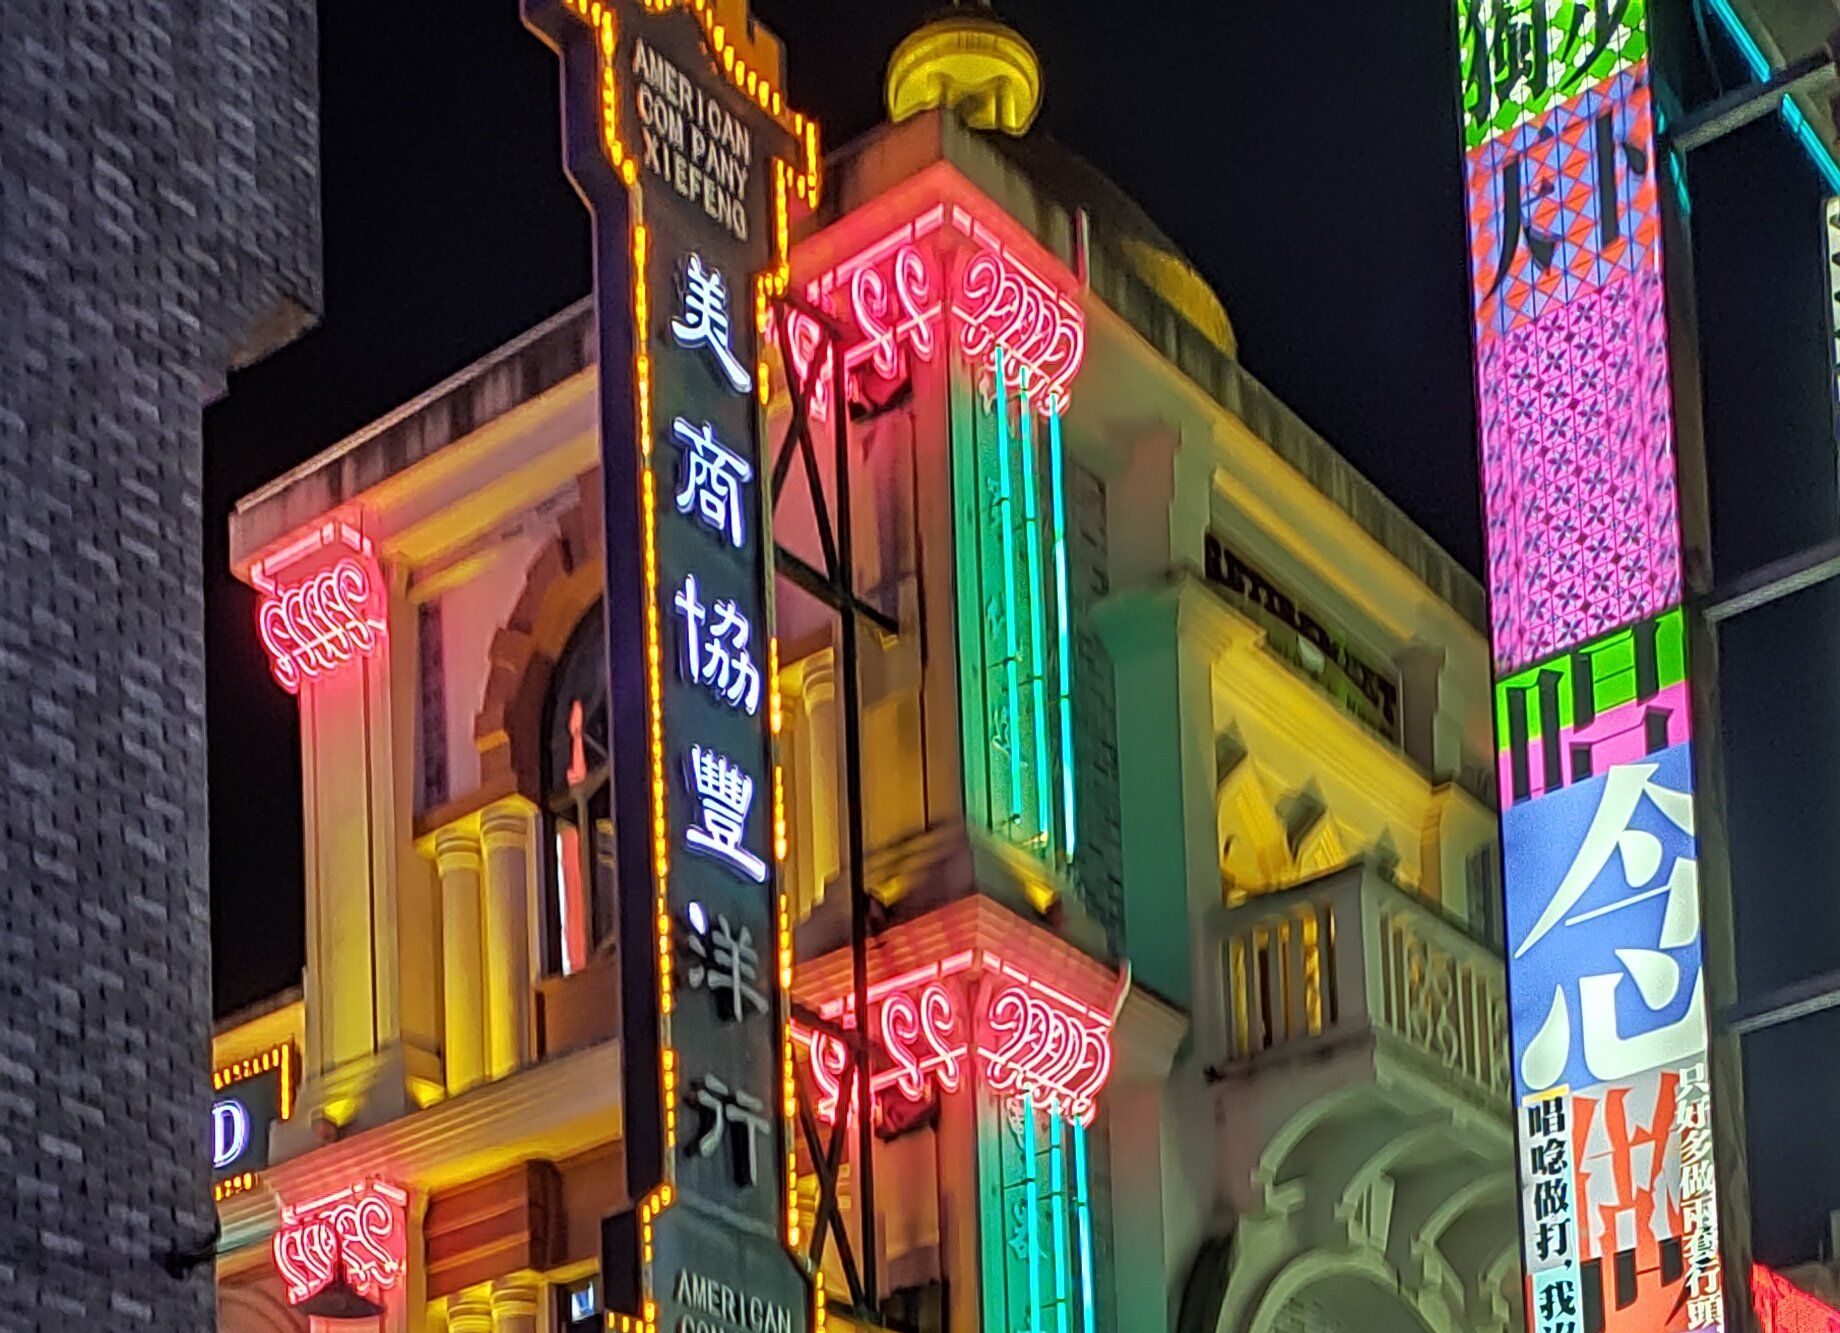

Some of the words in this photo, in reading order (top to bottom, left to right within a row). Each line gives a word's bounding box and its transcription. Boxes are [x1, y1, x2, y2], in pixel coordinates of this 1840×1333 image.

[633, 37, 750, 166] AMERICAN
[643, 125, 748, 243] XIEFENG
[212, 1100, 249, 1168] D
